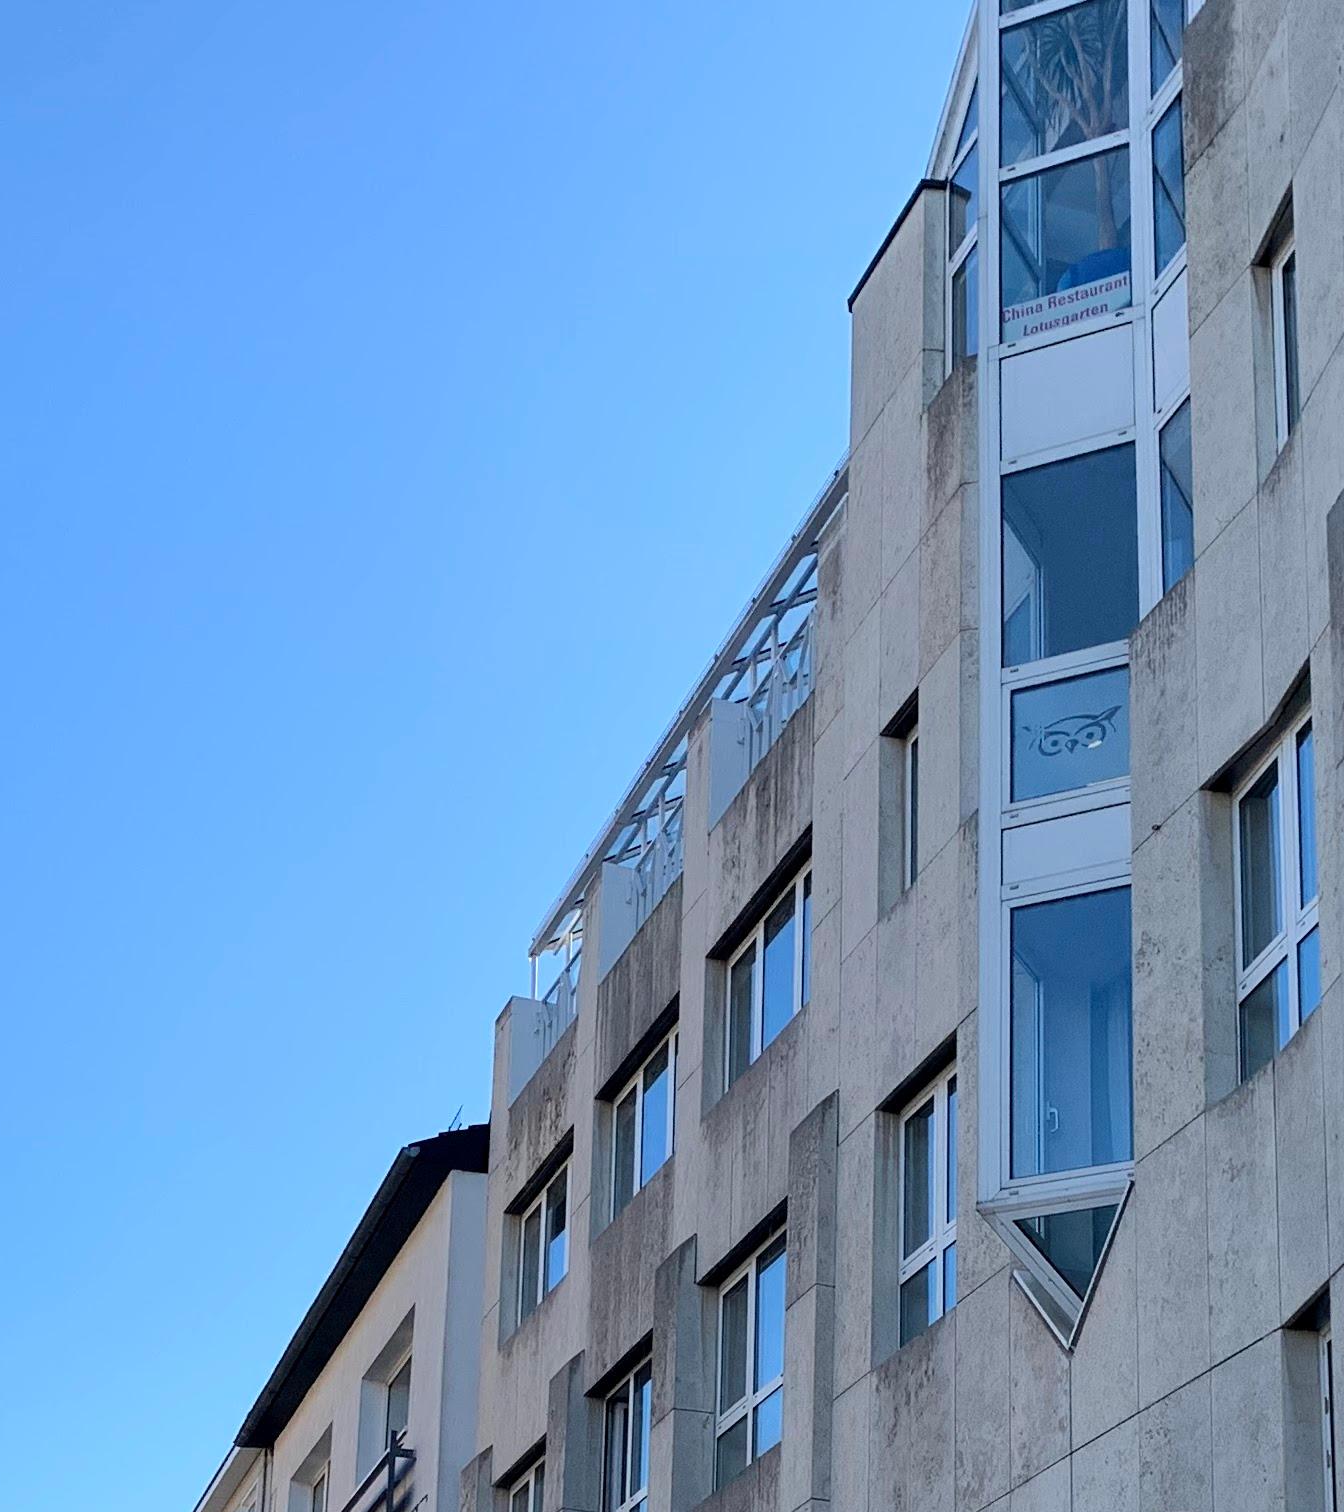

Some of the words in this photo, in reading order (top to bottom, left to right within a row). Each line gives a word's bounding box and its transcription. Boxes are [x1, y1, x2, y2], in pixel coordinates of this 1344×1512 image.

[1002, 303, 1043, 323] China
[1047, 276, 1127, 309] Restaurant
[1023, 303, 1109, 337] Lotusgarten
